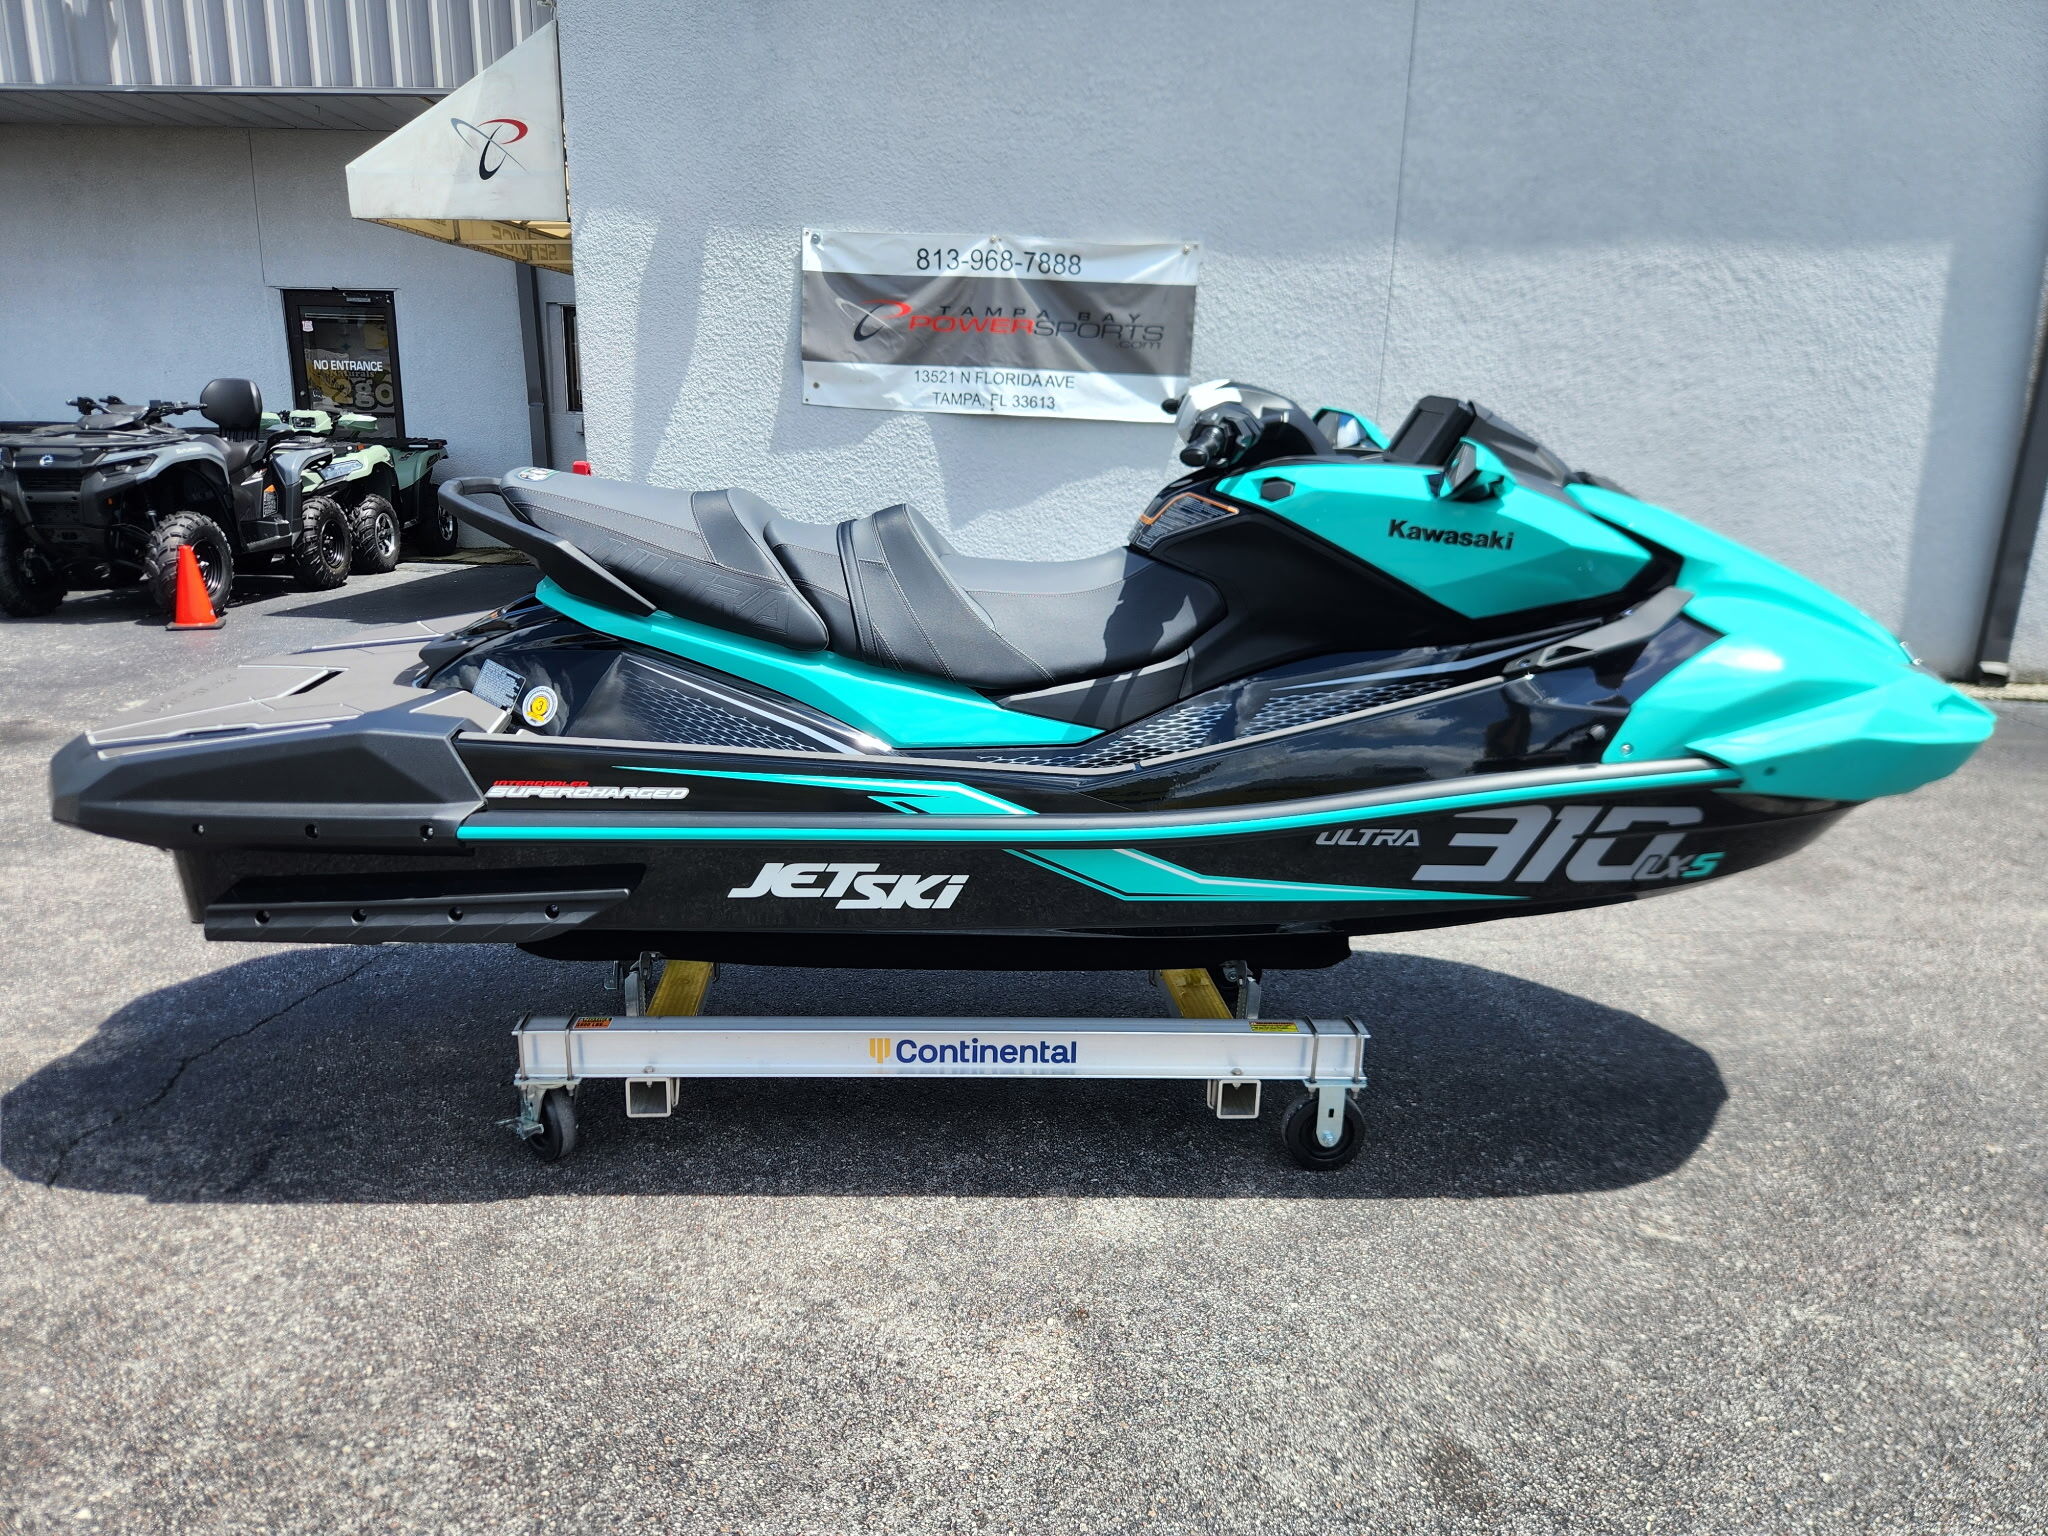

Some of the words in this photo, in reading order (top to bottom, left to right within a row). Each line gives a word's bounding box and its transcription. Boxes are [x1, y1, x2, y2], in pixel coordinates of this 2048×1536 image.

[916, 248, 1082, 275] 813-968-7888
[940, 305, 1050, 319] TAMPA
[1077, 312, 1143, 323] BAY
[908, 315, 1165, 341] POWERSPORTS
[314, 359, 329, 370] NO
[331, 360, 384, 371] ENTRANCE
[914, 370, 954, 384] 13521
[961, 371, 971, 384] N
[975, 372, 1043, 387] FLORIDA
[1044, 375, 1075, 388] AVE
[932, 392, 986, 408] TAMPA,
[990, 394, 1007, 408] FL
[1012, 395, 1056, 410] 33613
[1387, 519, 1516, 550] Kawasaki
[485, 786, 690, 799] SUPERCHARGED
[1315, 828, 1420, 847] ULTRA
[1411, 804, 1704, 883] 310
[896, 1037, 1077, 1064] Continental
